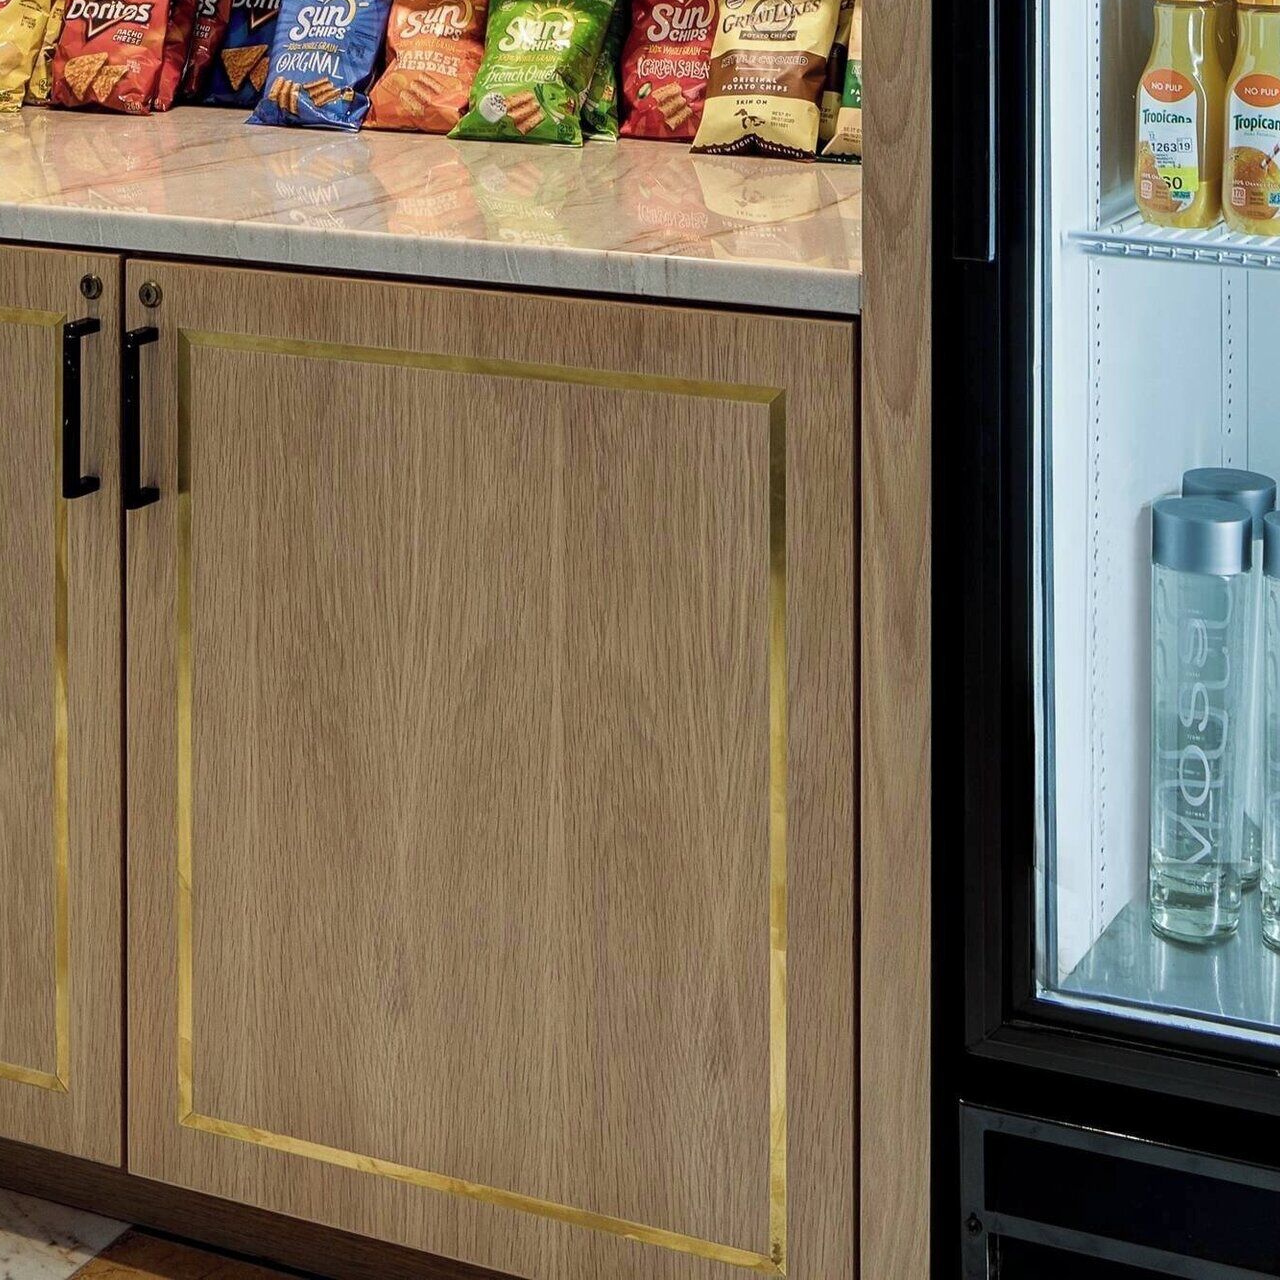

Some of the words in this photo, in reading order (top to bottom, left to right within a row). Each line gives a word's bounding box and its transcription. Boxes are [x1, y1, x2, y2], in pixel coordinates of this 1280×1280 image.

[66, 0, 153, 22] Doritos
[723, 5, 770, 34] GREAT
[773, 0, 822, 25] LAKES
[400, 3, 470, 38] Sun
[117, 29, 143, 39] NACHO
[308, 26, 347, 40] CHIPS
[421, 23, 462, 41] CHIPS
[498, 14, 574, 51] Sun
[669, 28, 708, 42] CHIPS
[113, 34, 142, 45] CHEESE
[523, 39, 570, 52] CHIPS
[276, 50, 343, 79] ORIGINAL
[394, 59, 458, 77] HEDDAR
[721, 55, 756, 68] KETTLE
[757, 55, 809, 67] COOKED
[483, 65, 525, 86] French
[732, 76, 777, 84] ORIGINAL
[759, 84, 788, 92] CHIPS
[1151, 81, 1163, 90] NO
[1165, 82, 1183, 92] PULP
[1244, 87, 1259, 96] NO
[1261, 87, 1279, 97] PULP
[724, 136, 754, 152] WEIGHT
